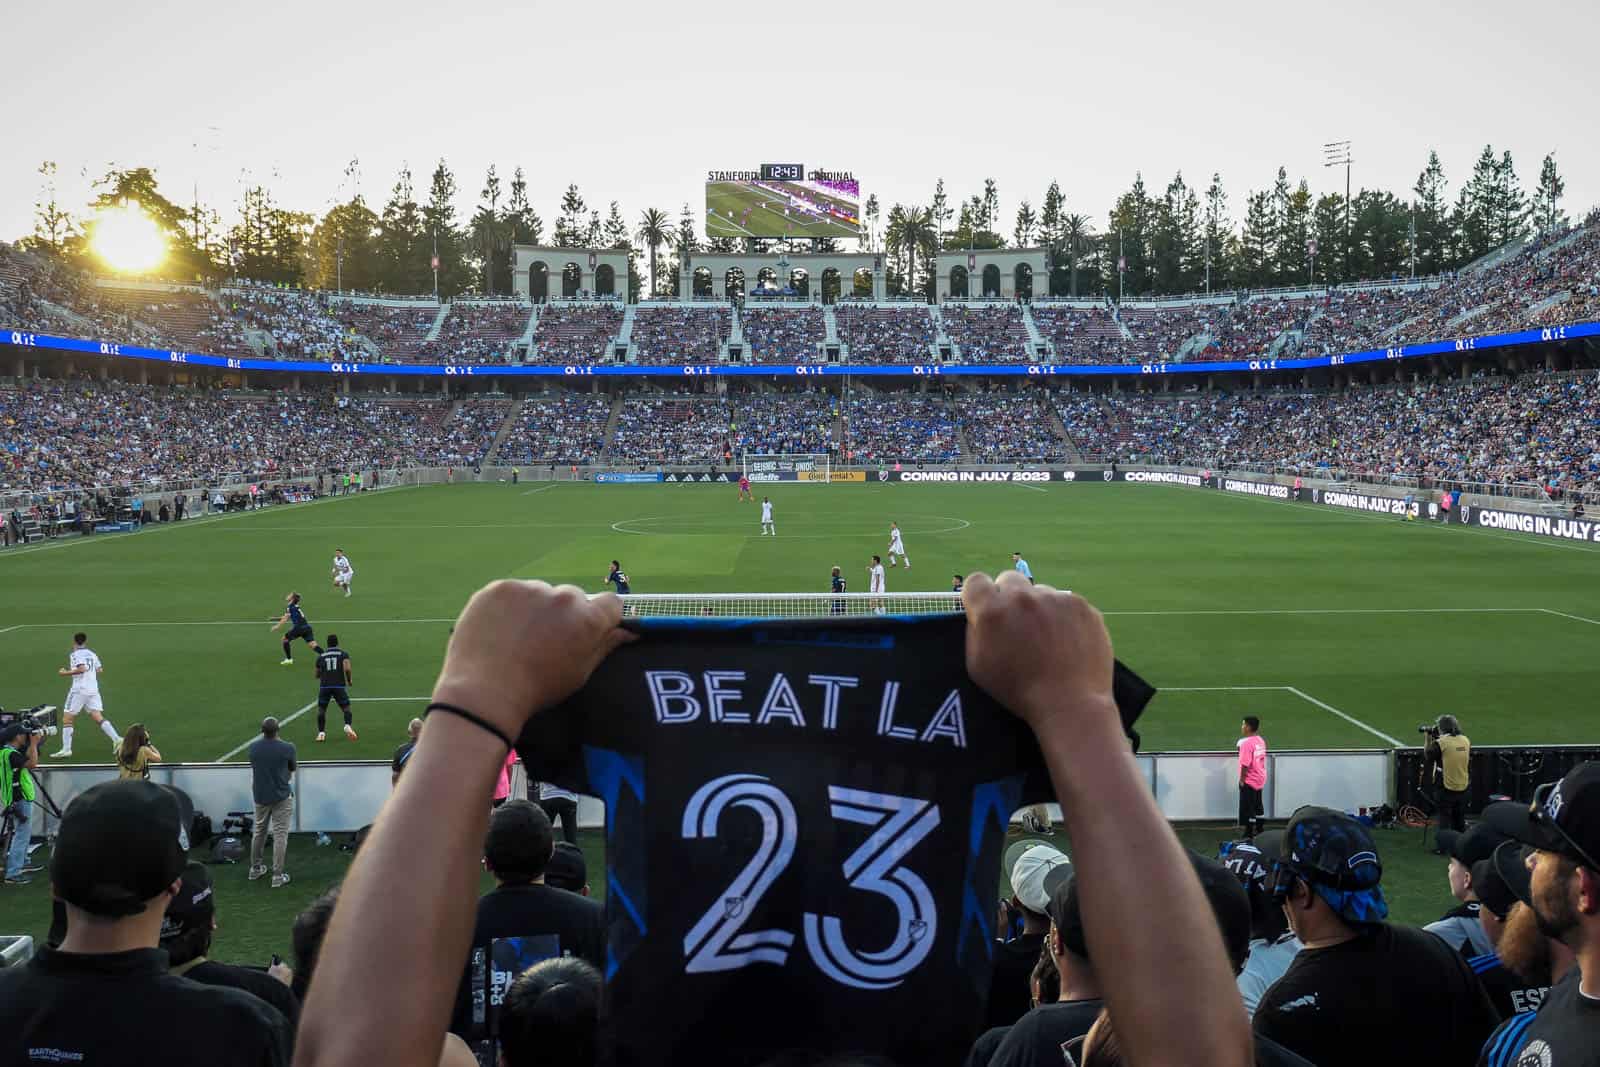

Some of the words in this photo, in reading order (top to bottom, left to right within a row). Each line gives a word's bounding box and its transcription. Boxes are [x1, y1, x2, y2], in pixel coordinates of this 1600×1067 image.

[708, 171, 757, 181] STANFORD
[770, 167, 797, 178] 12:43
[748, 472, 780, 481] Gillette
[900, 472, 958, 481] COMING
[960, 472, 974, 481] IN
[976, 472, 1010, 481] JULY
[1012, 472, 1050, 481] 2023
[1125, 472, 1172, 482] COMING
[1225, 480, 1247, 492] COMING
[1269, 485, 1288, 498] 2023
[1324, 492, 1357, 508] COMING
[1358, 496, 1368, 510] IN
[1368, 497, 1391, 513] JULY
[1391, 500, 1419, 517] 203
[1479, 509, 1534, 533] COMING
[1535, 517, 1551, 535] IN
[1552, 520, 1592, 541] JULY
[324, 657, 337, 671] 11
[646, 670, 859, 729] BEAT
[877, 680, 967, 749] LA
[681, 773, 941, 990] 23
